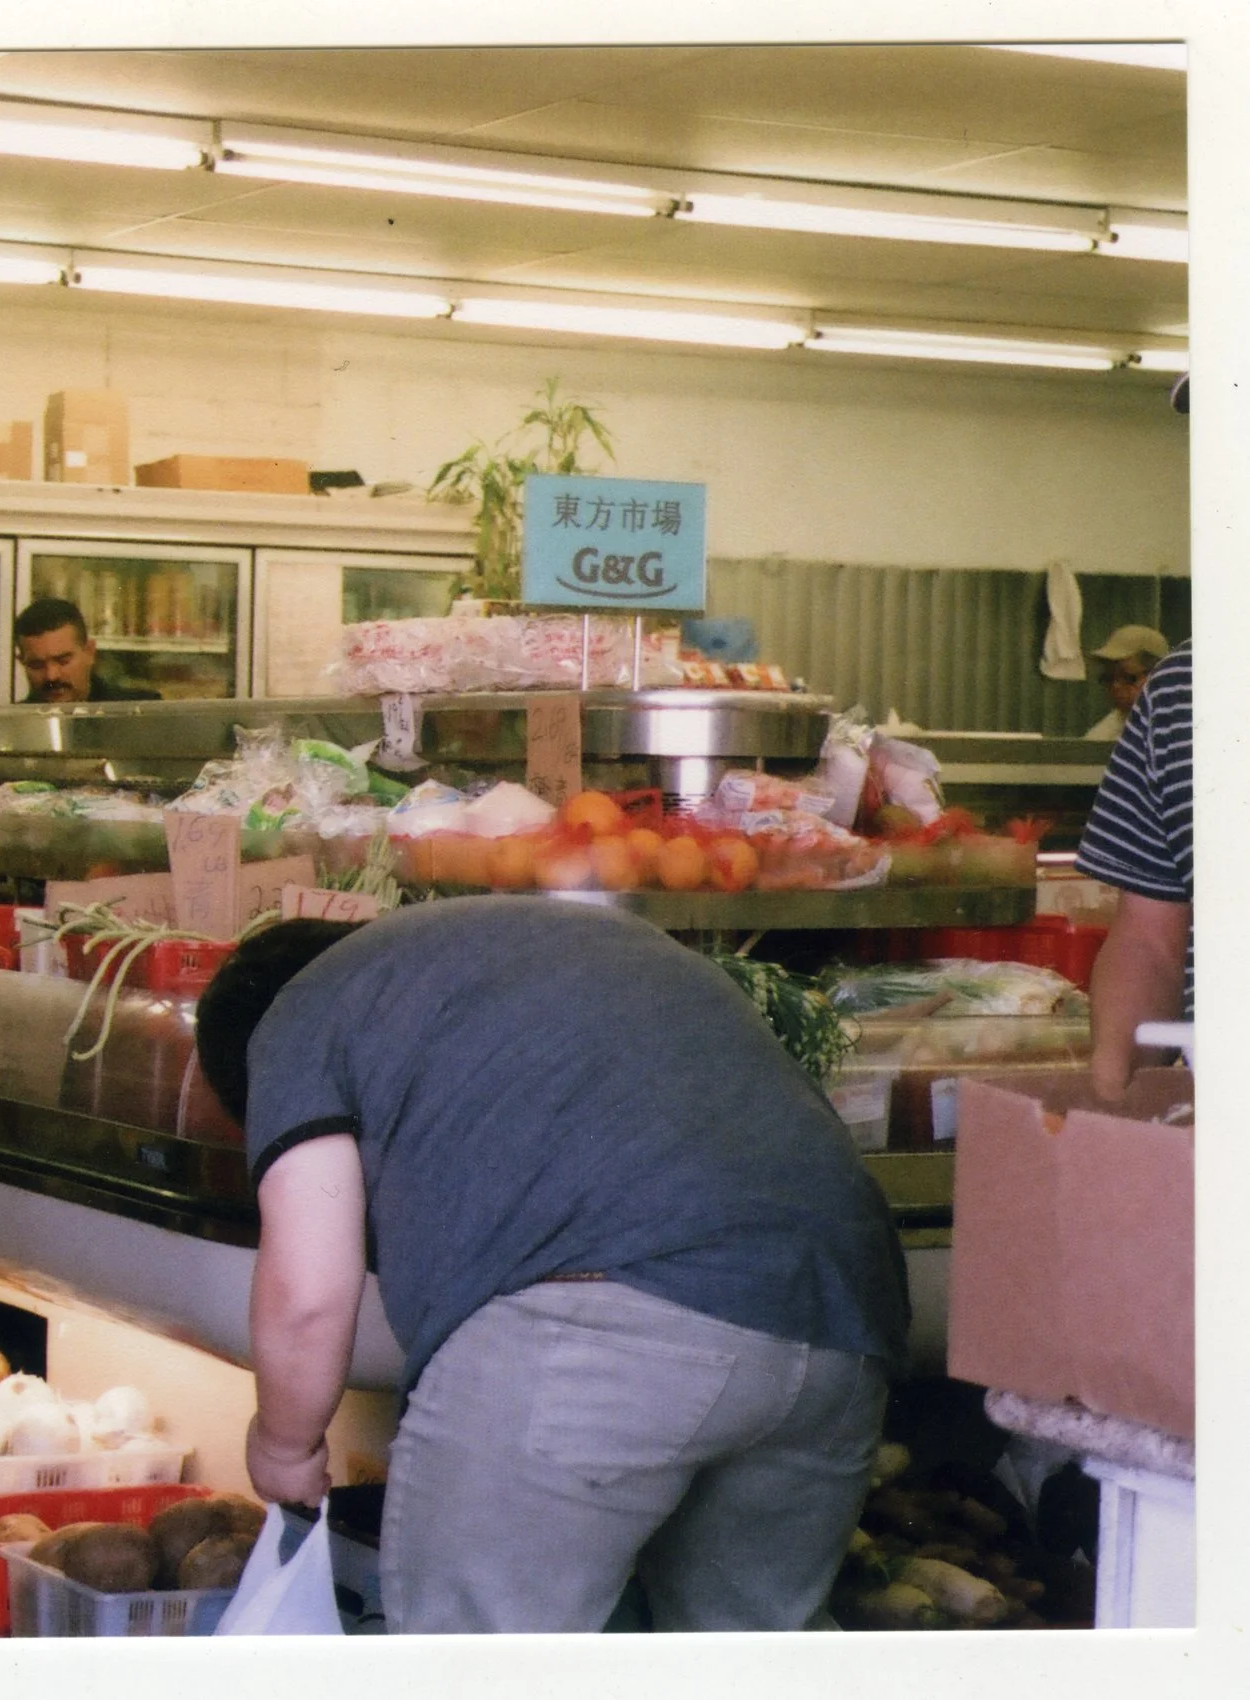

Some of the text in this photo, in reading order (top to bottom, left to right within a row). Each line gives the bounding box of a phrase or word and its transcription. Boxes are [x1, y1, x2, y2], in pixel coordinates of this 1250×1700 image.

[552, 493, 682, 536] 東方市場
[573, 547, 664, 587] G&G
